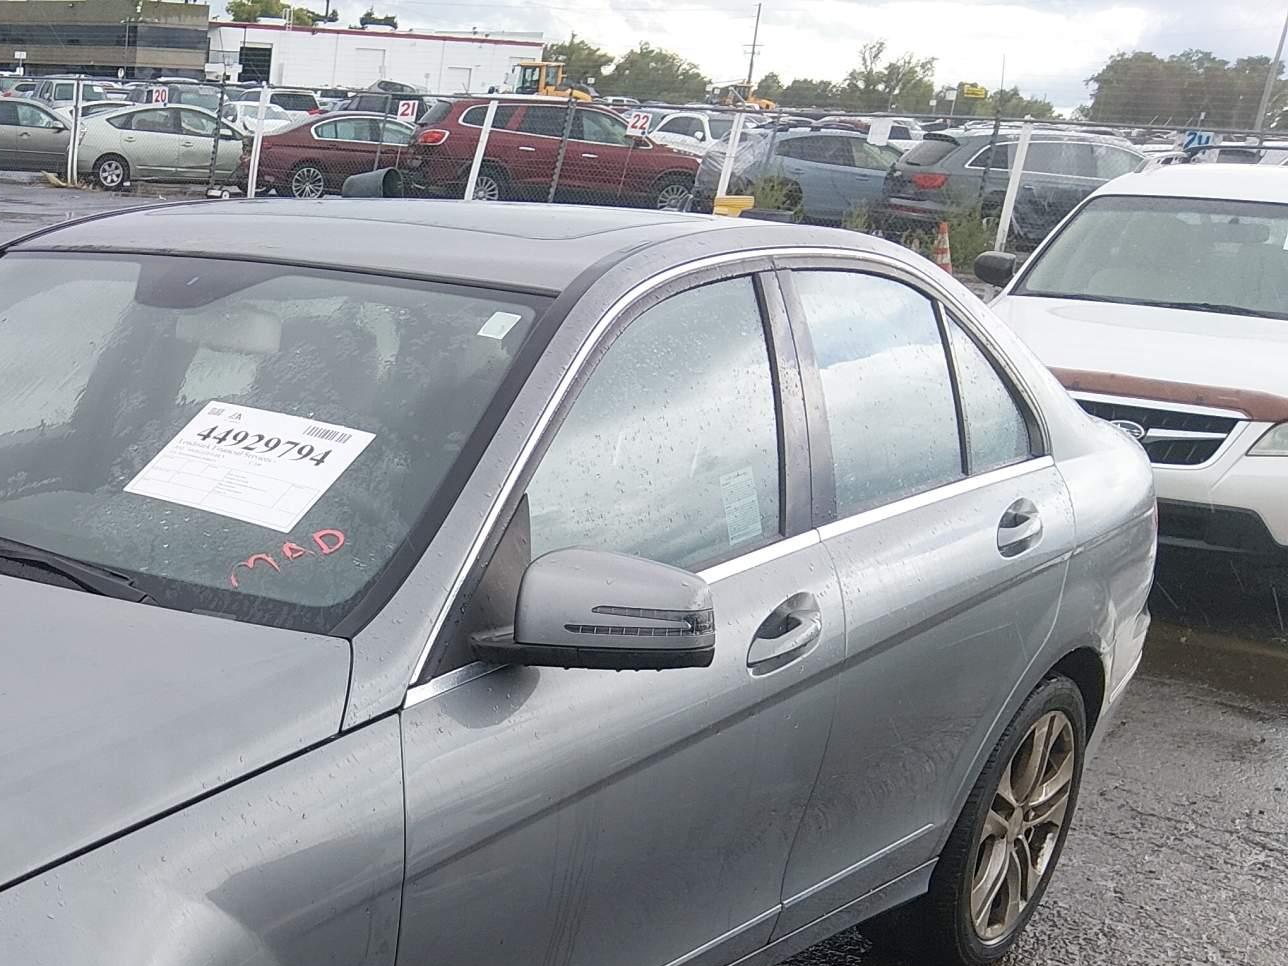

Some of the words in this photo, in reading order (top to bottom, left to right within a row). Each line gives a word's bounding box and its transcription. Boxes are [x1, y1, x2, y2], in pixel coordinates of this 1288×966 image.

[154, 90, 167, 103] 20
[400, 102, 416, 117] 21
[630, 113, 649, 130] 22
[196, 425, 333, 467] 44929794
